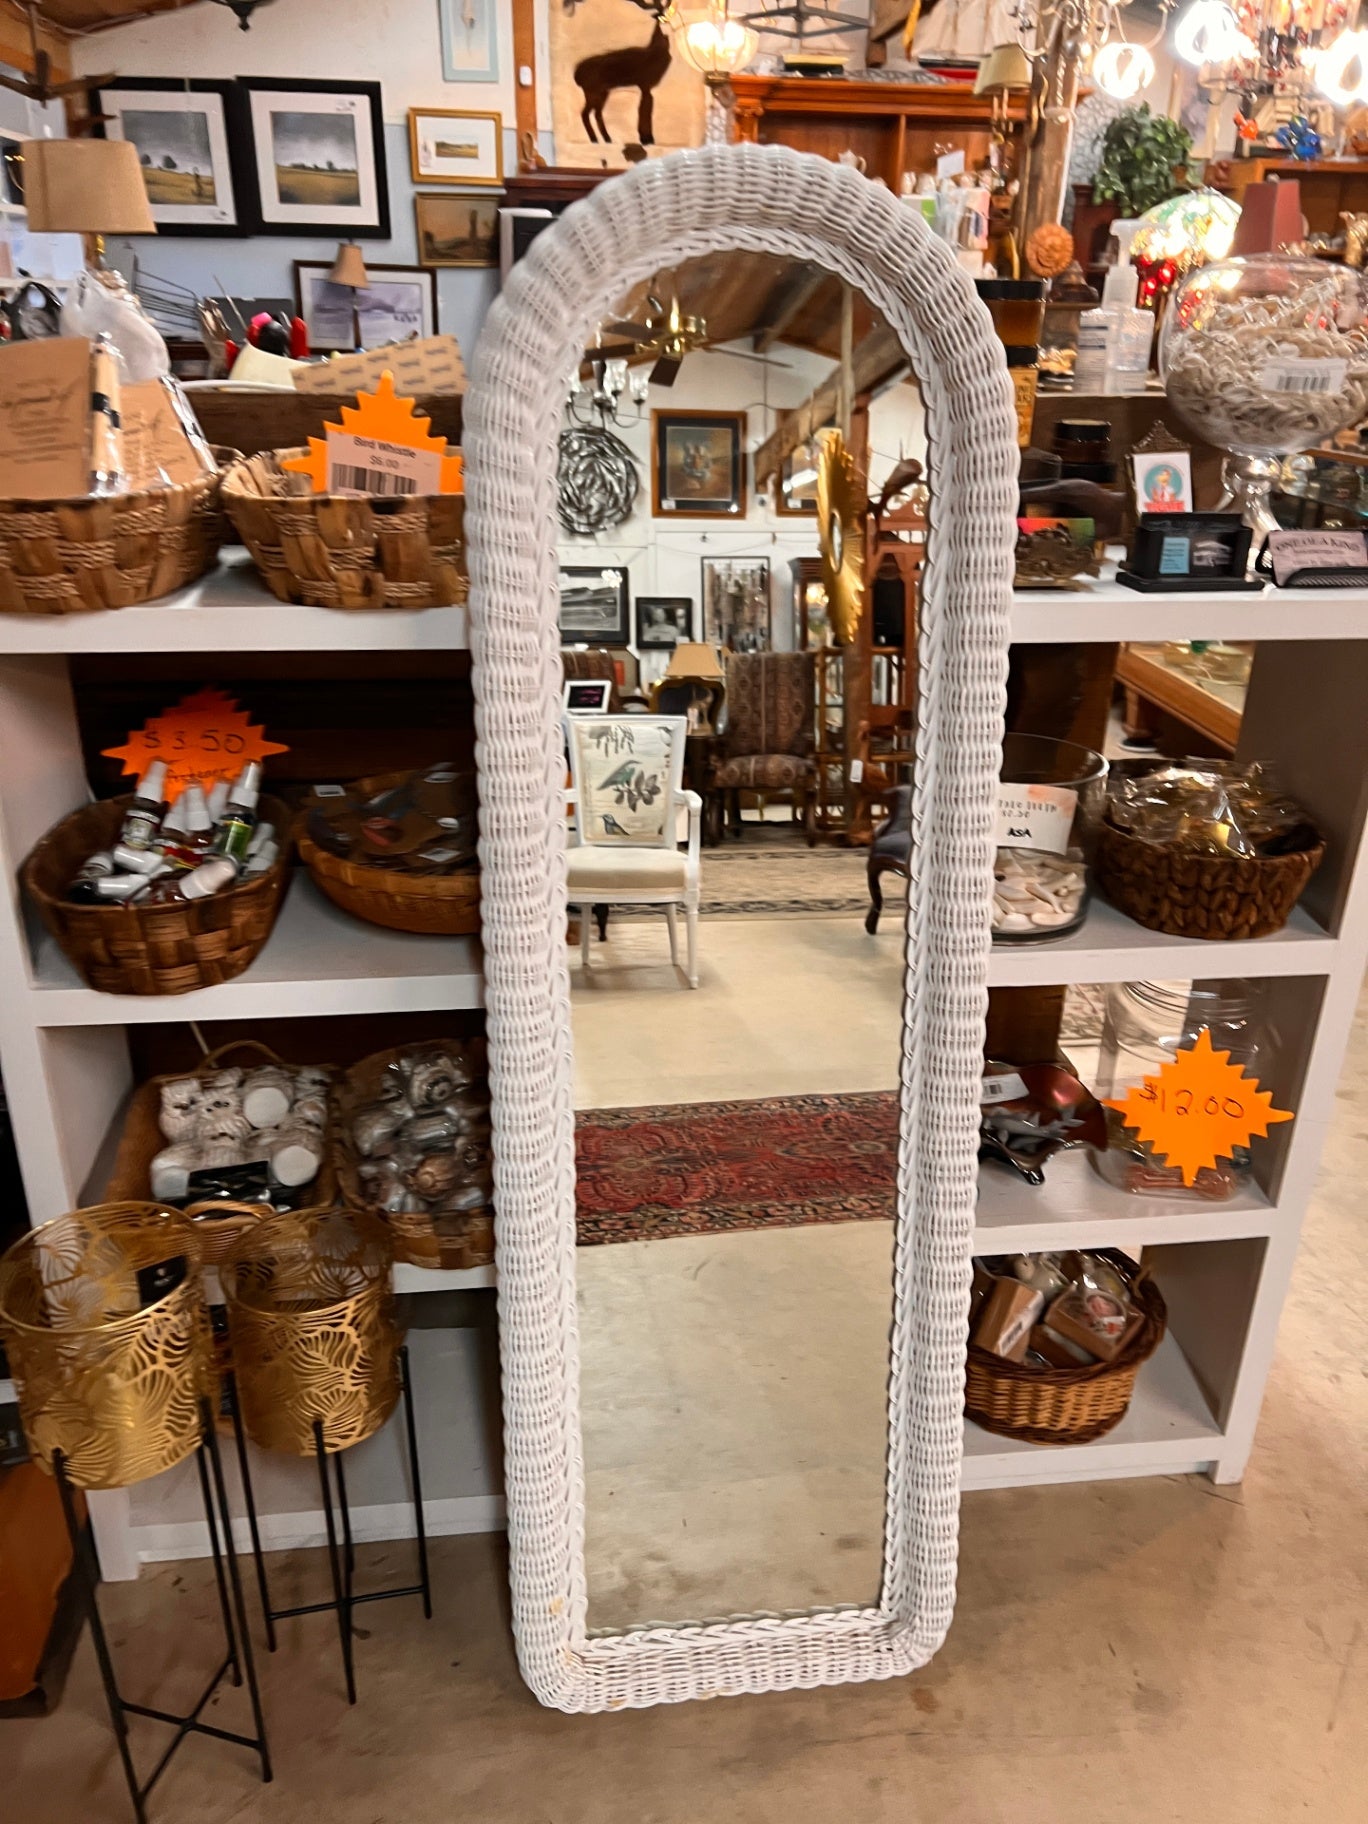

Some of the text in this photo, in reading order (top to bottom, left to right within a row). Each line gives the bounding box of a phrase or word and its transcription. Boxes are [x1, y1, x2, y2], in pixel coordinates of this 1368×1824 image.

[353, 435, 417, 459] Bird Whistle
[1139, 1082, 1245, 1119] $12.00
